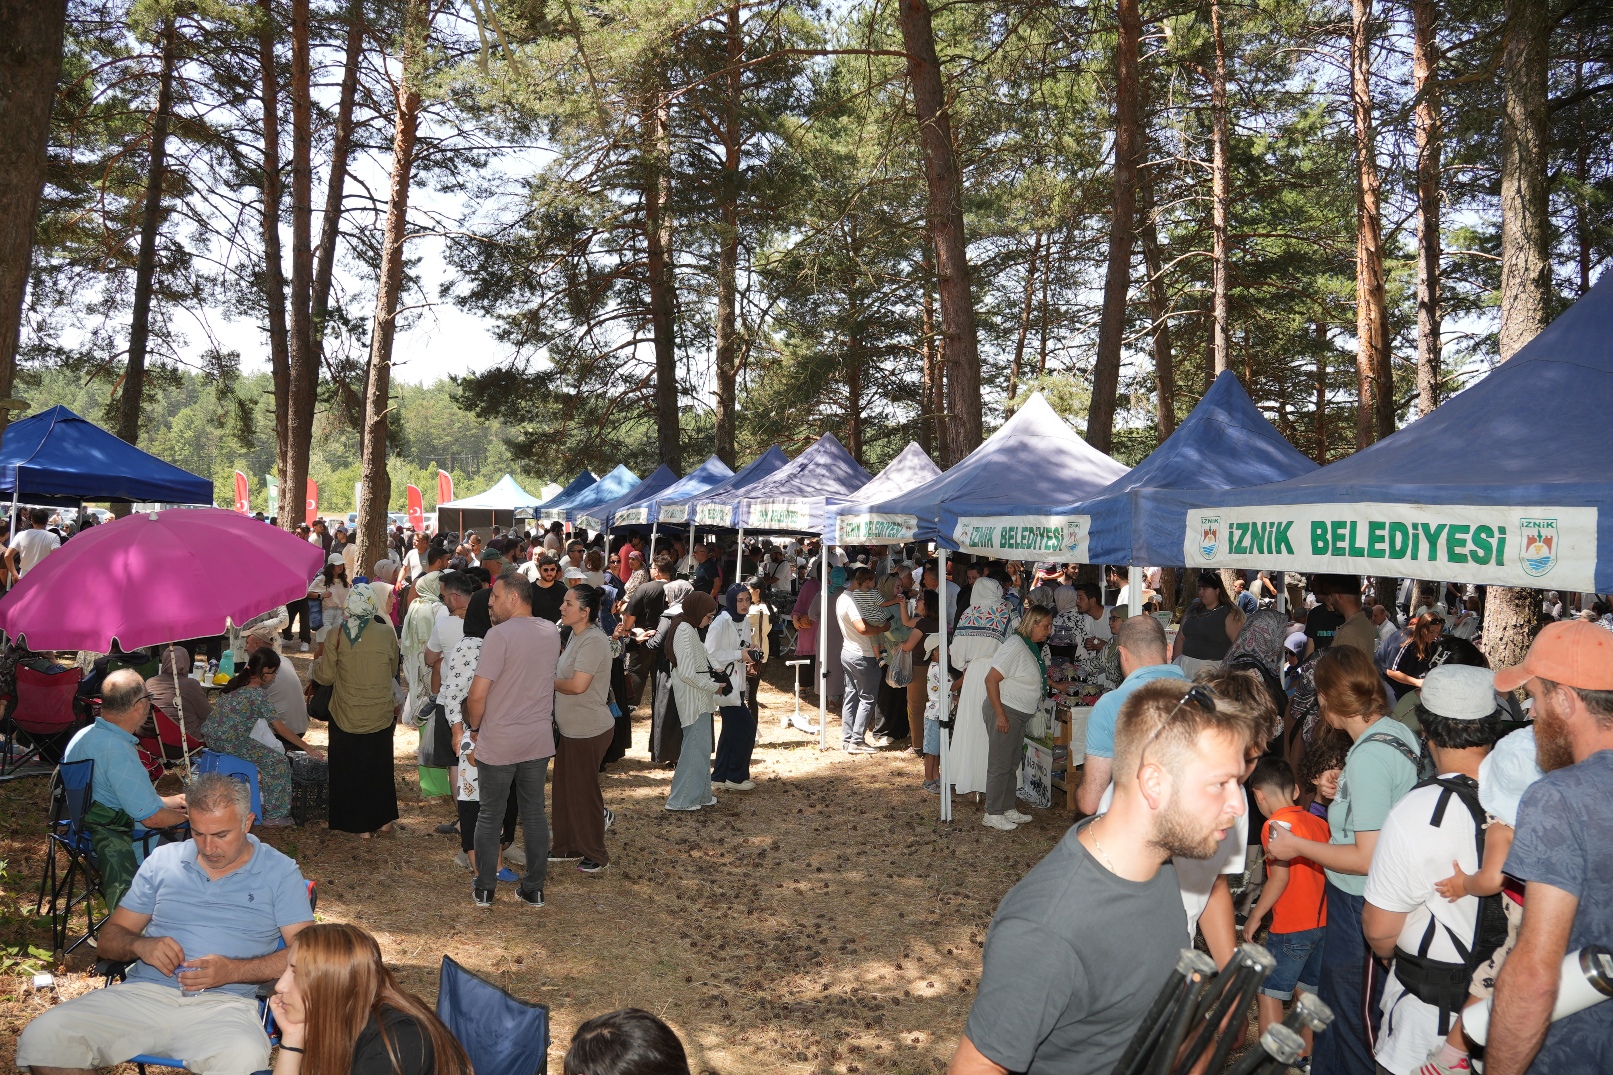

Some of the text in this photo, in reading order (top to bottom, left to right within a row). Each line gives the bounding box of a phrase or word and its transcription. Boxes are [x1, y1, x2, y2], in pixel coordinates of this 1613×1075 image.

[1521, 521, 1555, 529] İZNİK
[968, 526, 1065, 552] İZNİK BELEDİYESİ
[1228, 520, 1295, 555] İZNİK
[1311, 520, 1506, 567] BELEDİYESİ
